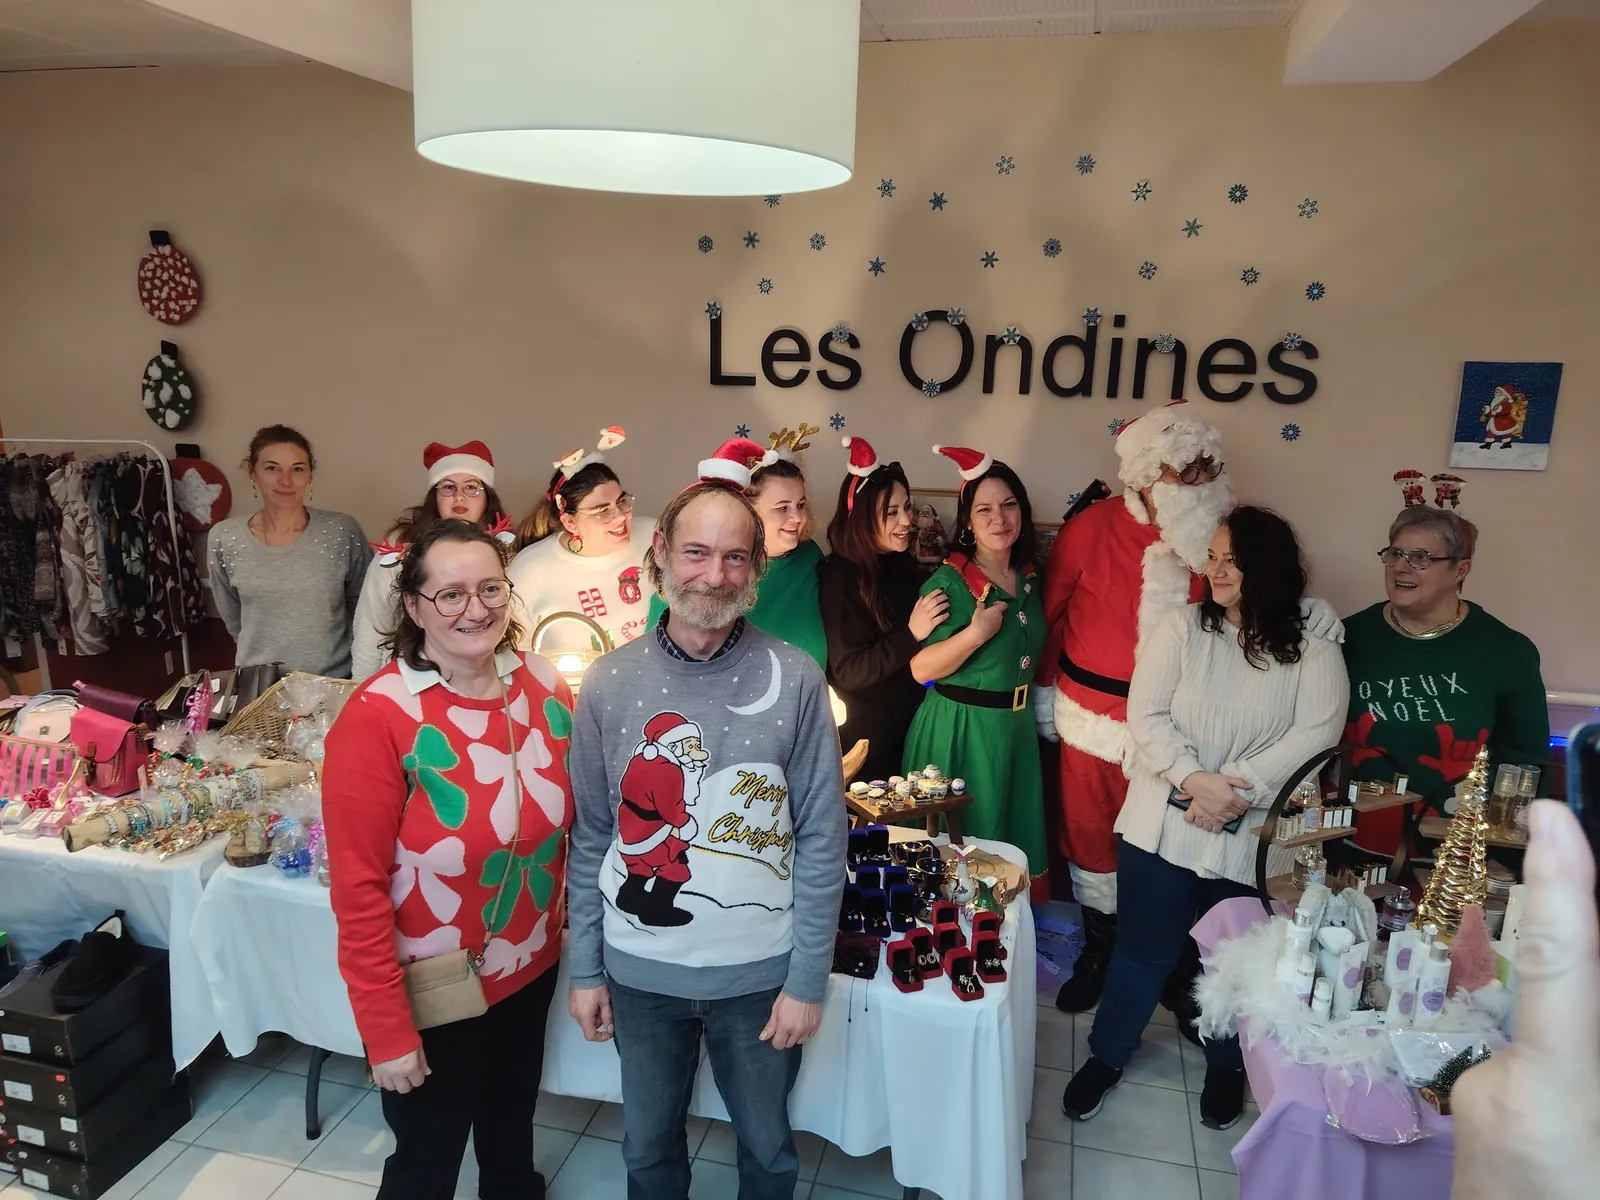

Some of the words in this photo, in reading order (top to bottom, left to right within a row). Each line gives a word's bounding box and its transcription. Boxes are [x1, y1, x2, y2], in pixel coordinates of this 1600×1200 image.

[706, 304, 863, 391] Les
[899, 308, 1320, 405] Ondines
[1358, 672, 1469, 700] OYEUX
[1367, 697, 1456, 722] NOËL
[730, 770, 788, 816] Merry
[708, 812, 793, 854] Christmas
